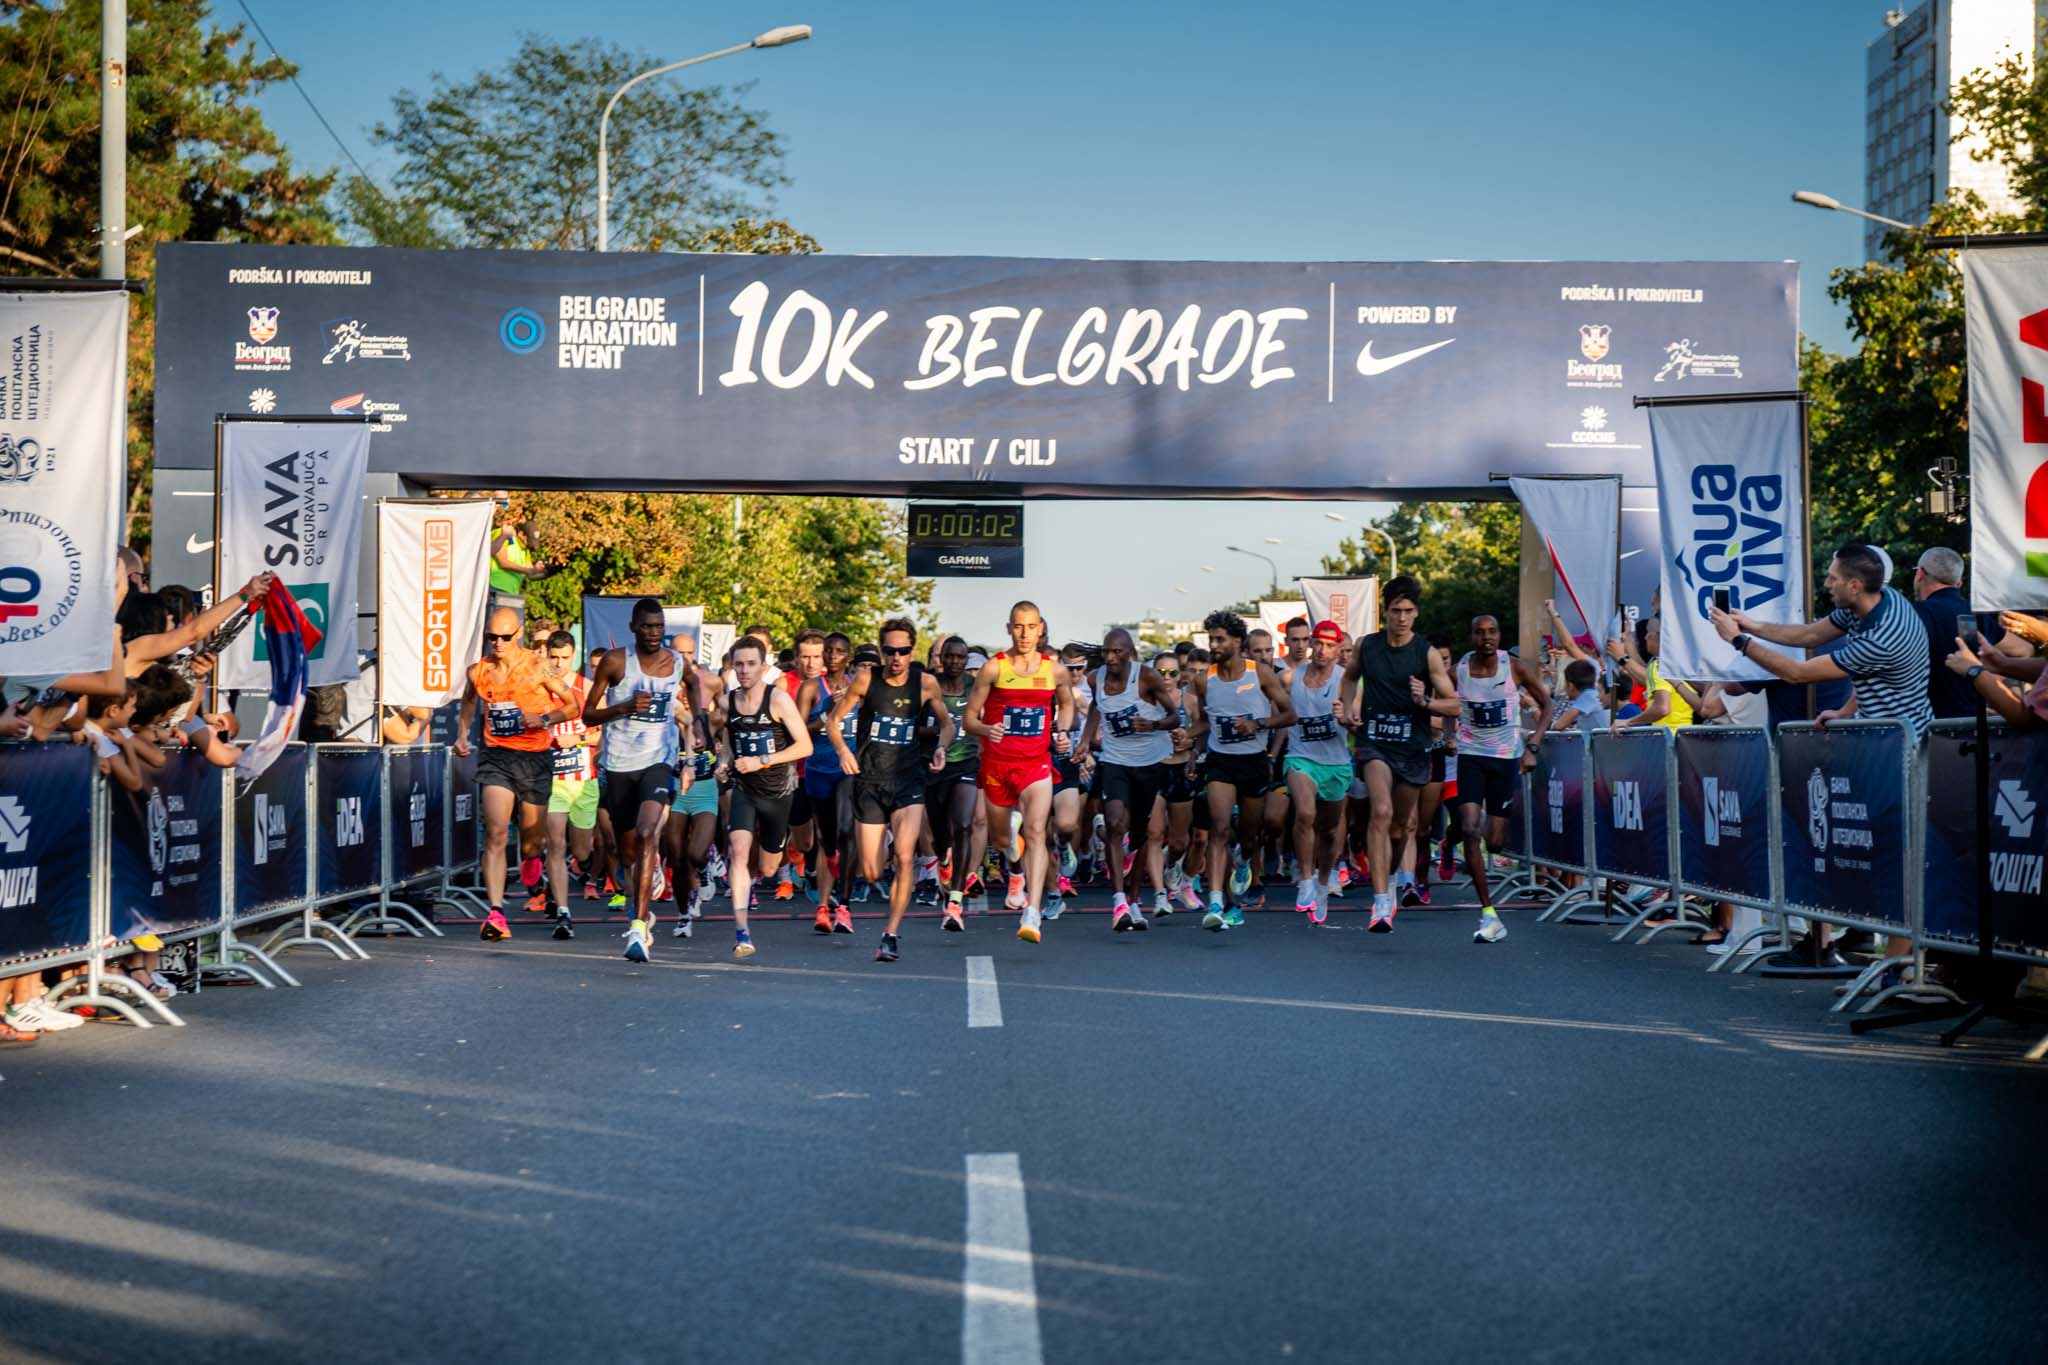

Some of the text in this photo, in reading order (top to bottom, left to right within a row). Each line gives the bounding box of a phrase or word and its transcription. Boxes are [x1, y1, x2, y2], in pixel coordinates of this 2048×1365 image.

[229, 266, 372, 285] PODRŠKA I POKROVITELJI
[1561, 284, 1704, 303] PODRŠKA I POKROVITELJI
[559, 295, 667, 321] BELGRADE
[1358, 305, 1458, 325] POWERED BY
[559, 320, 678, 346] MARATHON
[719, 281, 1309, 391] 10K BELGRADE
[234, 341, 292, 365] Београд
[558, 344, 625, 369] EVENT
[12, 335, 24, 421] ПОШТАНСКА
[28, 324, 41, 421] ШТЕДИОНИЦА
[1567, 358, 1623, 382] Београд
[46, 447, 56, 472] 1921
[899, 436, 1057, 466] START / CILJ
[264, 451, 299, 567] SAVA
[303, 449, 316, 567] OSIGURAVAJUĆA
[915, 513, 1017, 537] 0:00:02
[938, 555, 990, 566] GARMIN
[649, 704, 658, 714] 2
[1484, 712, 1490, 720] 1
[889, 727, 898, 737] 5
[1020, 718, 1032, 729] 15
[1377, 724, 1402, 735] 1709
[749, 742, 758, 752] 3
[1719, 790, 1742, 823] SAVA
[0, 866, 39, 909] ОШТА
